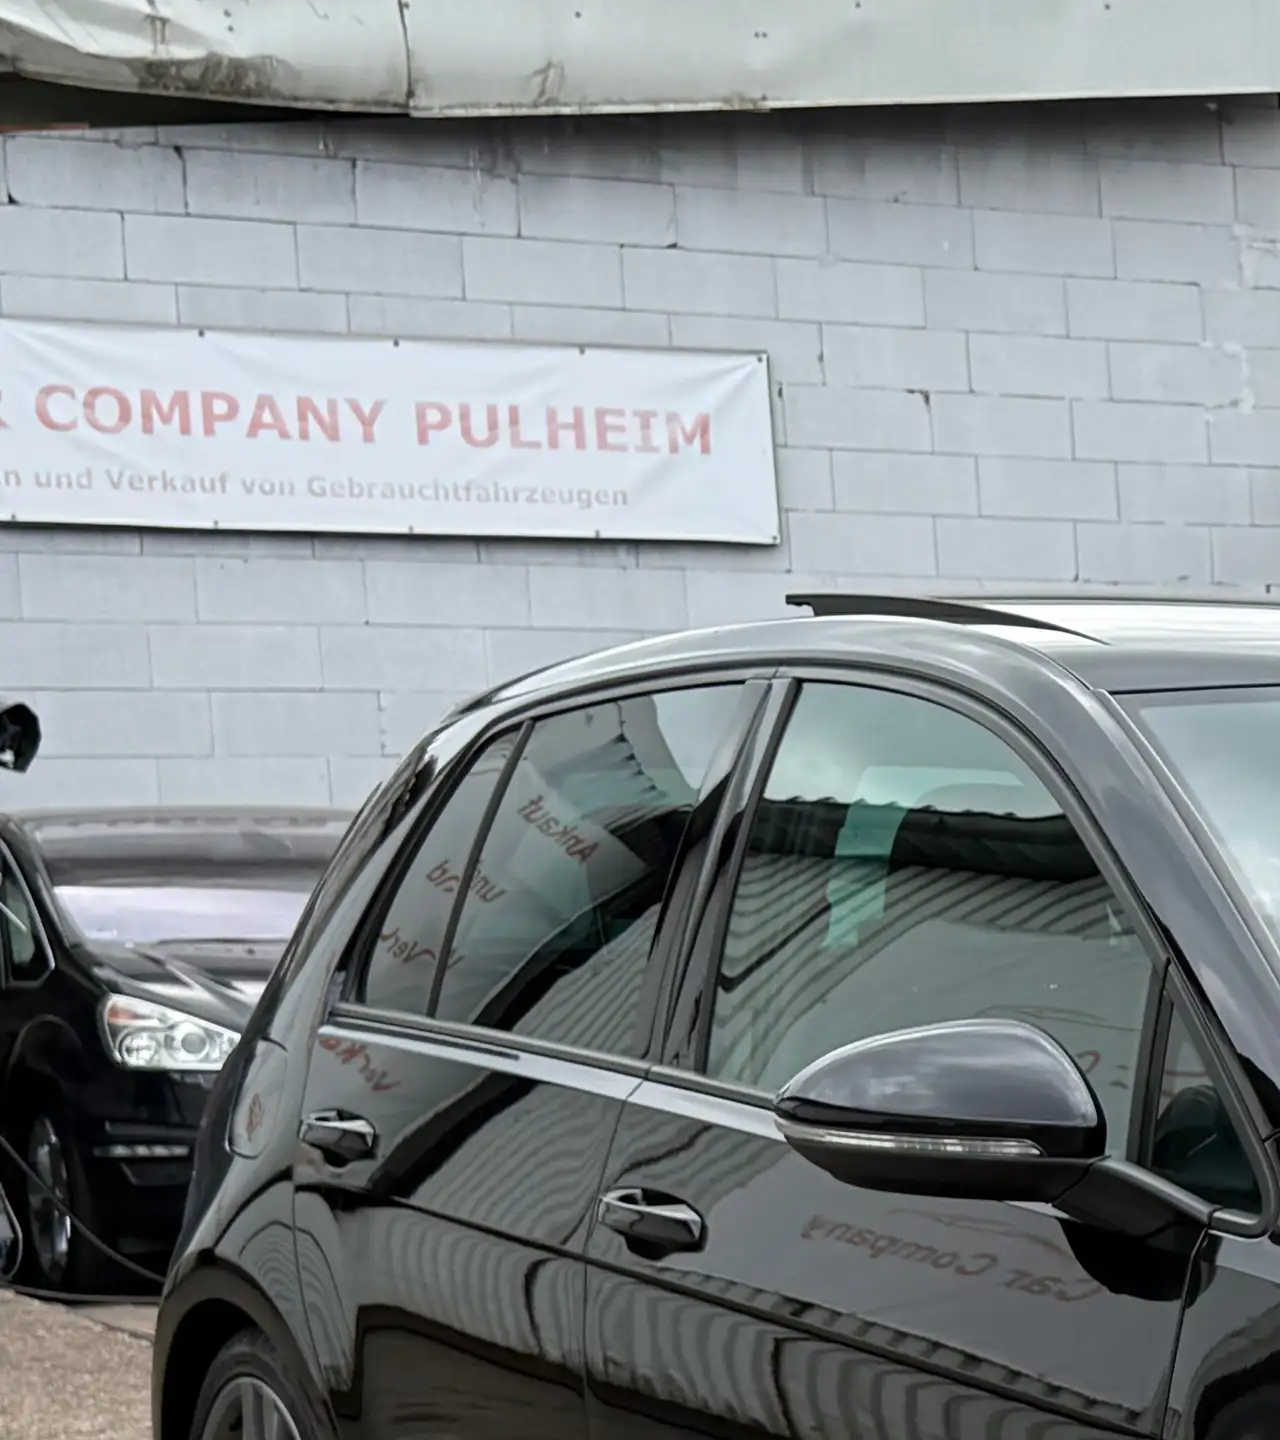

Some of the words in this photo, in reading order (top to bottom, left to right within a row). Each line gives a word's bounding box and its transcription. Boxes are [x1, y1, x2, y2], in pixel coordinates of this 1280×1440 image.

[35, 384, 387, 443] COMPANY
[414, 401, 711, 455] PULHEIM
[34, 467, 92, 489] und
[104, 467, 230, 496] Verkauf
[240, 478, 296, 497] von
[307, 475, 628, 509] Gebrauchtfahrzeugen
